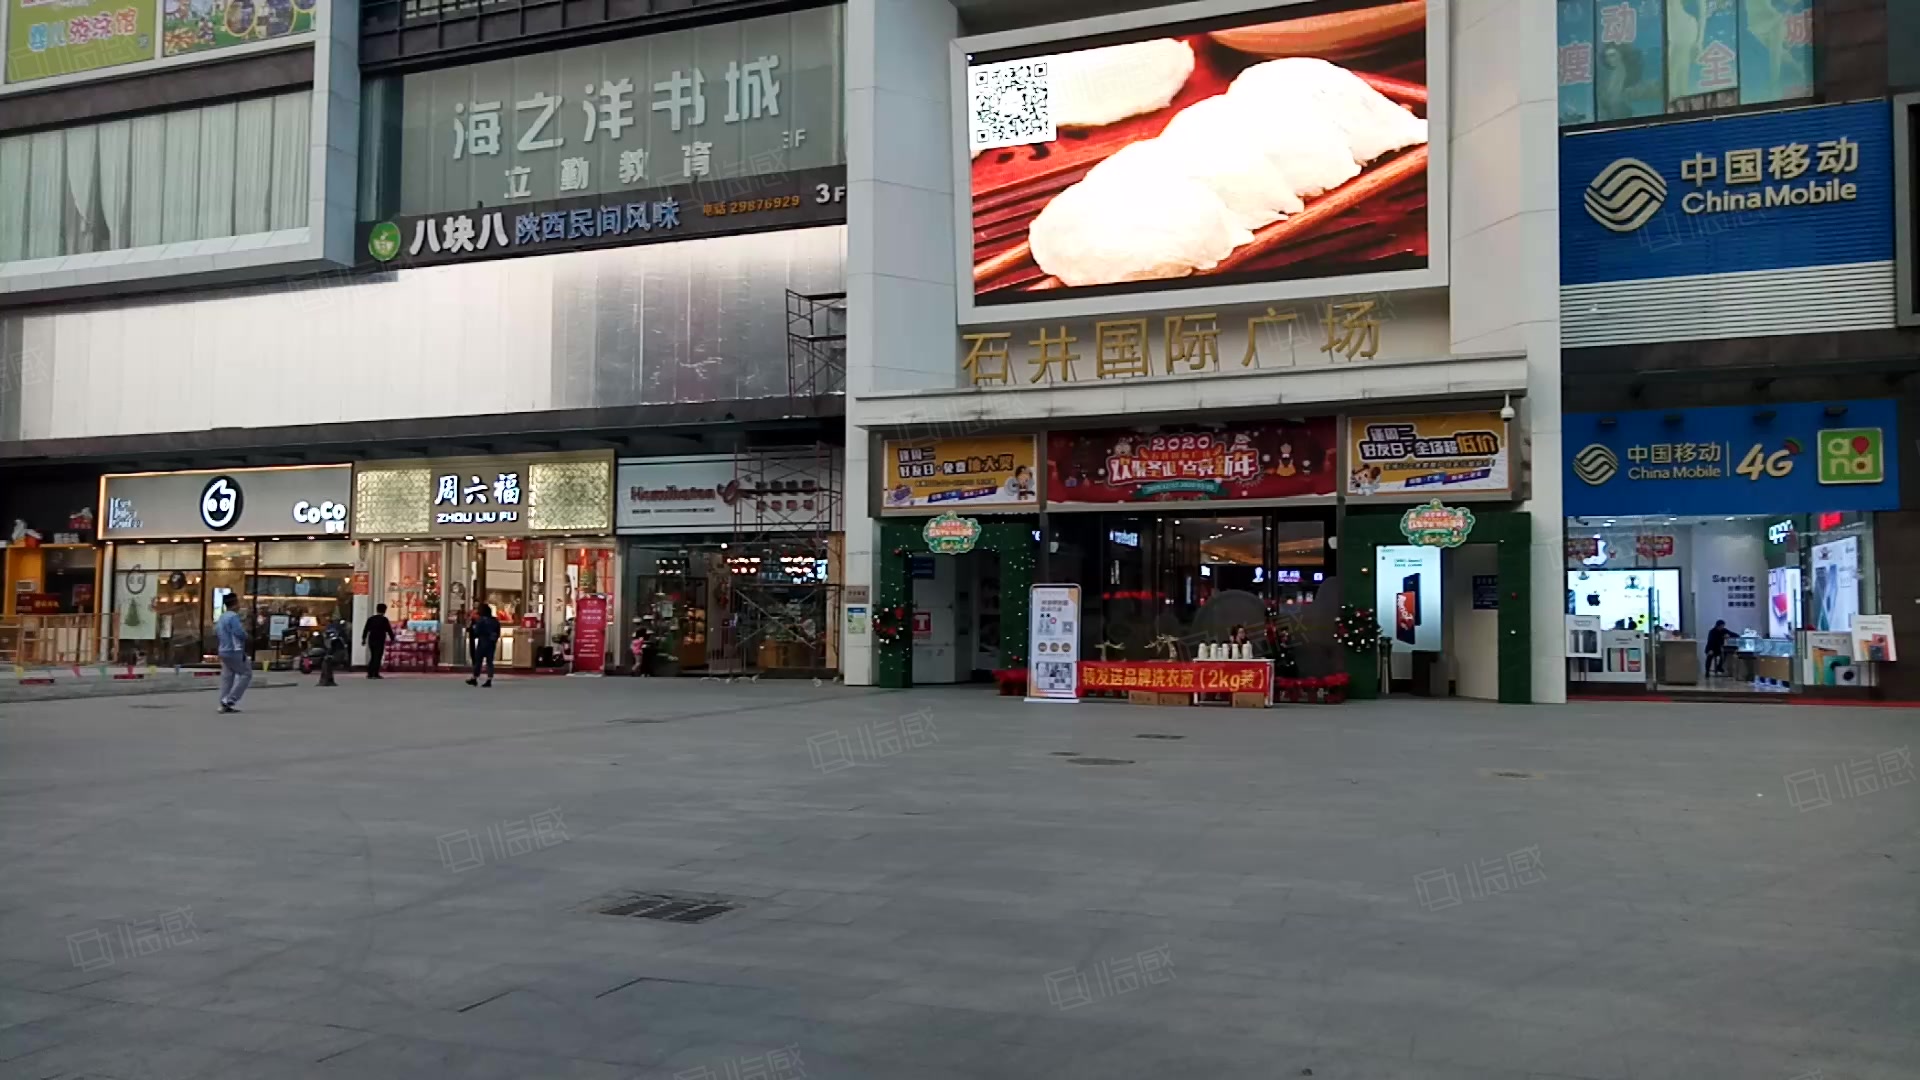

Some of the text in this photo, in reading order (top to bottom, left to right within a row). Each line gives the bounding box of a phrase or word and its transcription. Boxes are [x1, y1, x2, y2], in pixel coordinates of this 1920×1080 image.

[453, 55, 781, 160] 海之洋书城
[504, 141, 713, 199] 立勤教育
[1681, 137, 1859, 187] 中国移动
[409, 211, 510, 257] 八块八
[514, 196, 681, 246] 陕西民间风味
[731, 195, 800, 214] 29876929
[816, 183, 846, 204] 3F
[961, 303, 1381, 385] 石井国际广场
[1152, 435, 1210, 451] 2020
[1627, 441, 1721, 464] 中国移动
[1628, 465, 1721, 480] China Mobile
[1736, 443, 1793, 480] 4G
[434, 473, 521, 506] 周六福
[293, 500, 347, 524] CoCo
[436, 510, 518, 523] ZHOU LIU FU
[1712, 574, 1756, 583] Service
